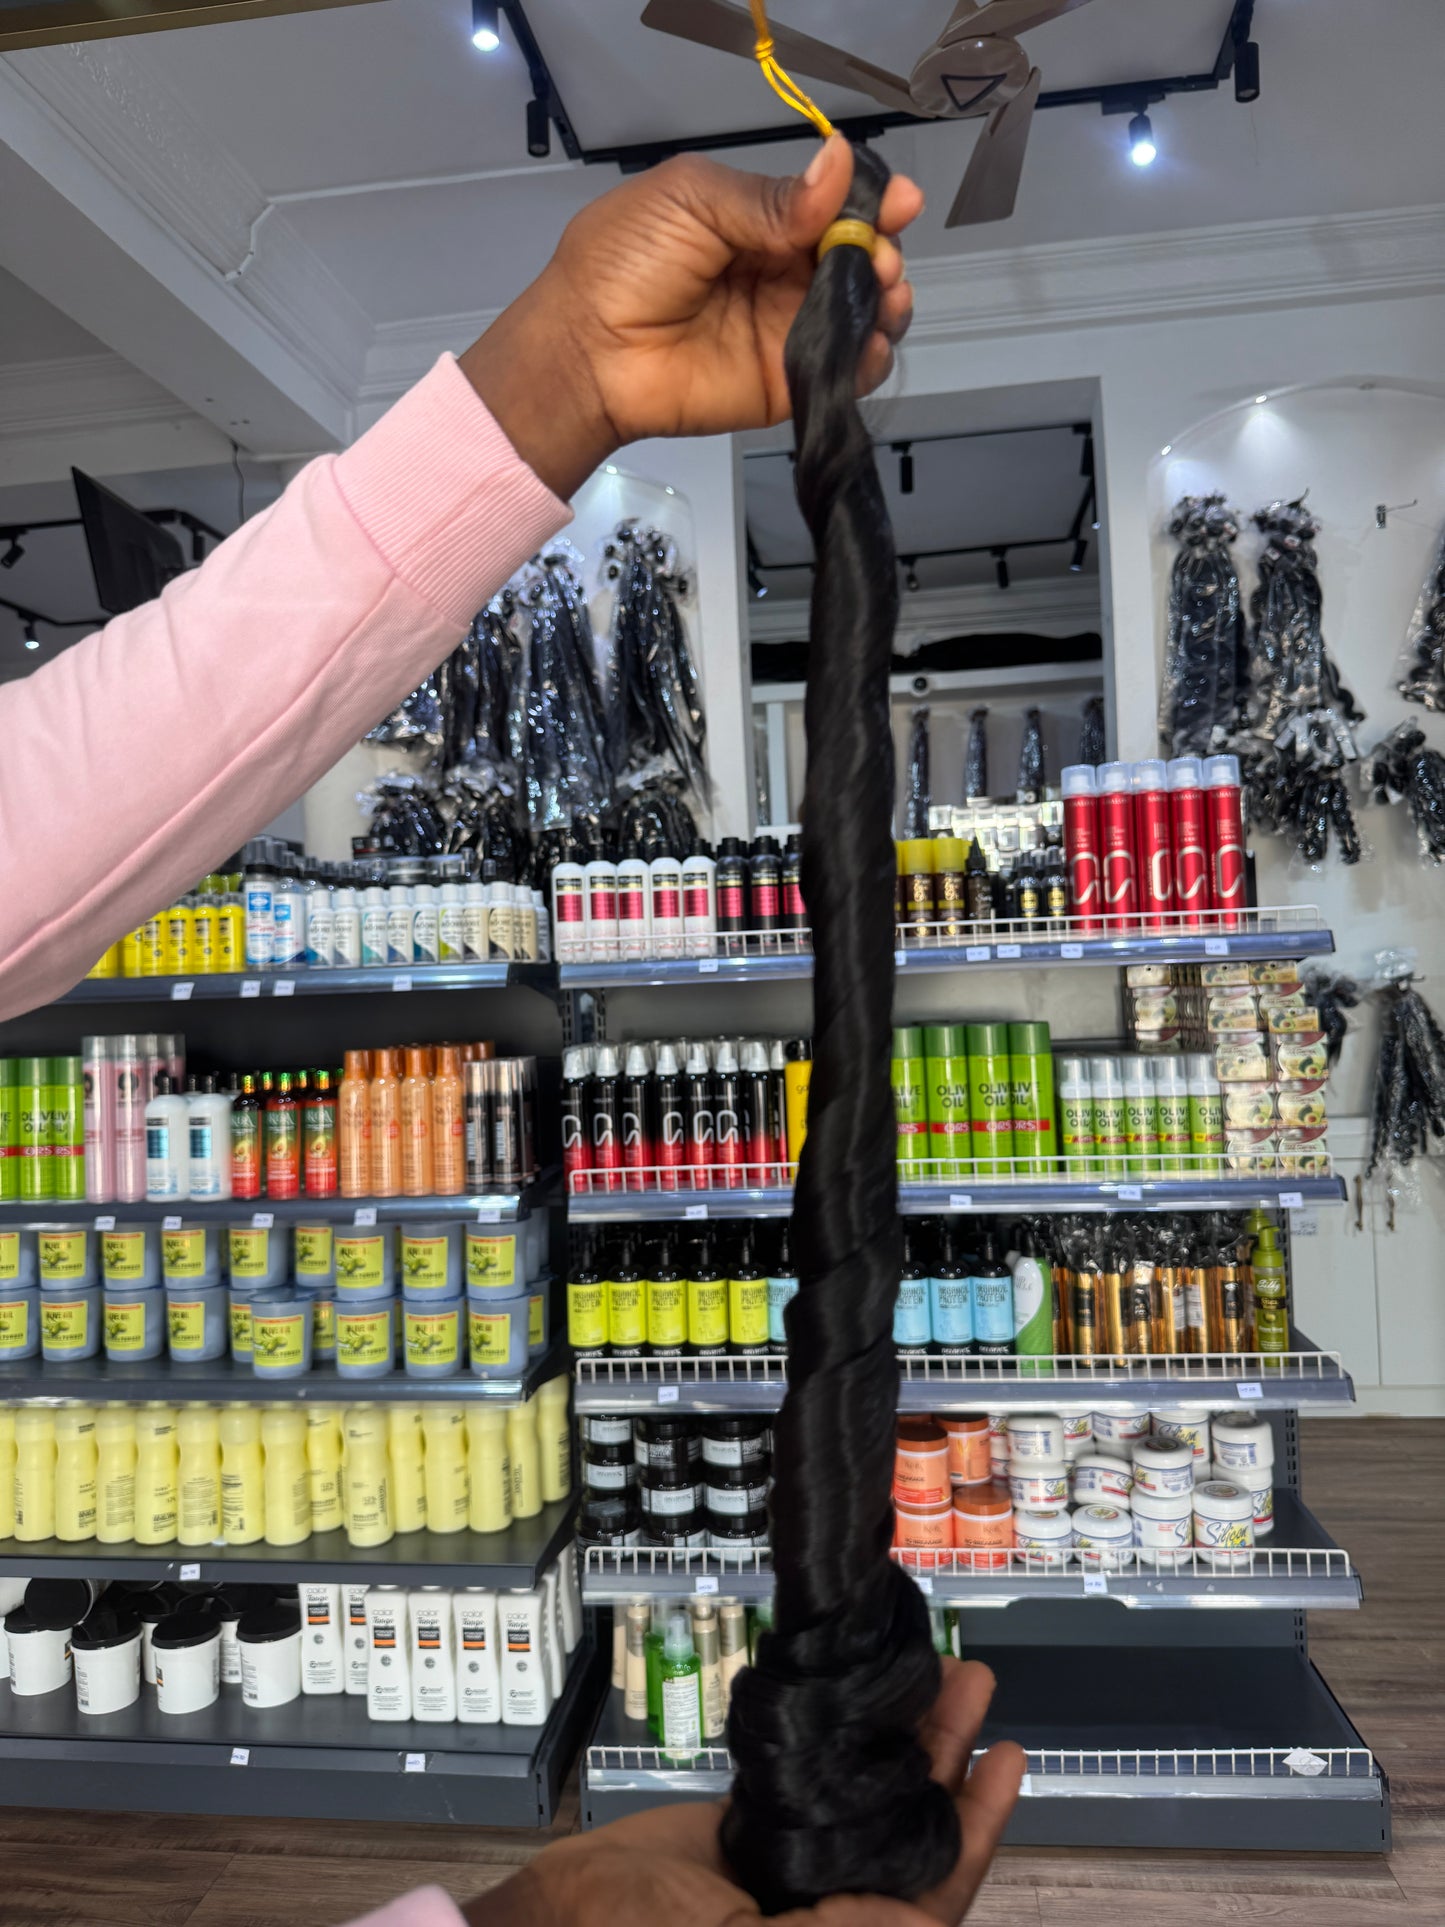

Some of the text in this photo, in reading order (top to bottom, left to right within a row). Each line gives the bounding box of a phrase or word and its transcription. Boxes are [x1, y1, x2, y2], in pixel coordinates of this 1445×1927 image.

[941, 1097, 964, 1108] OIL
[984, 1095, 1005, 1106] OIL
[1206, 1521, 1248, 1545] Silicon
